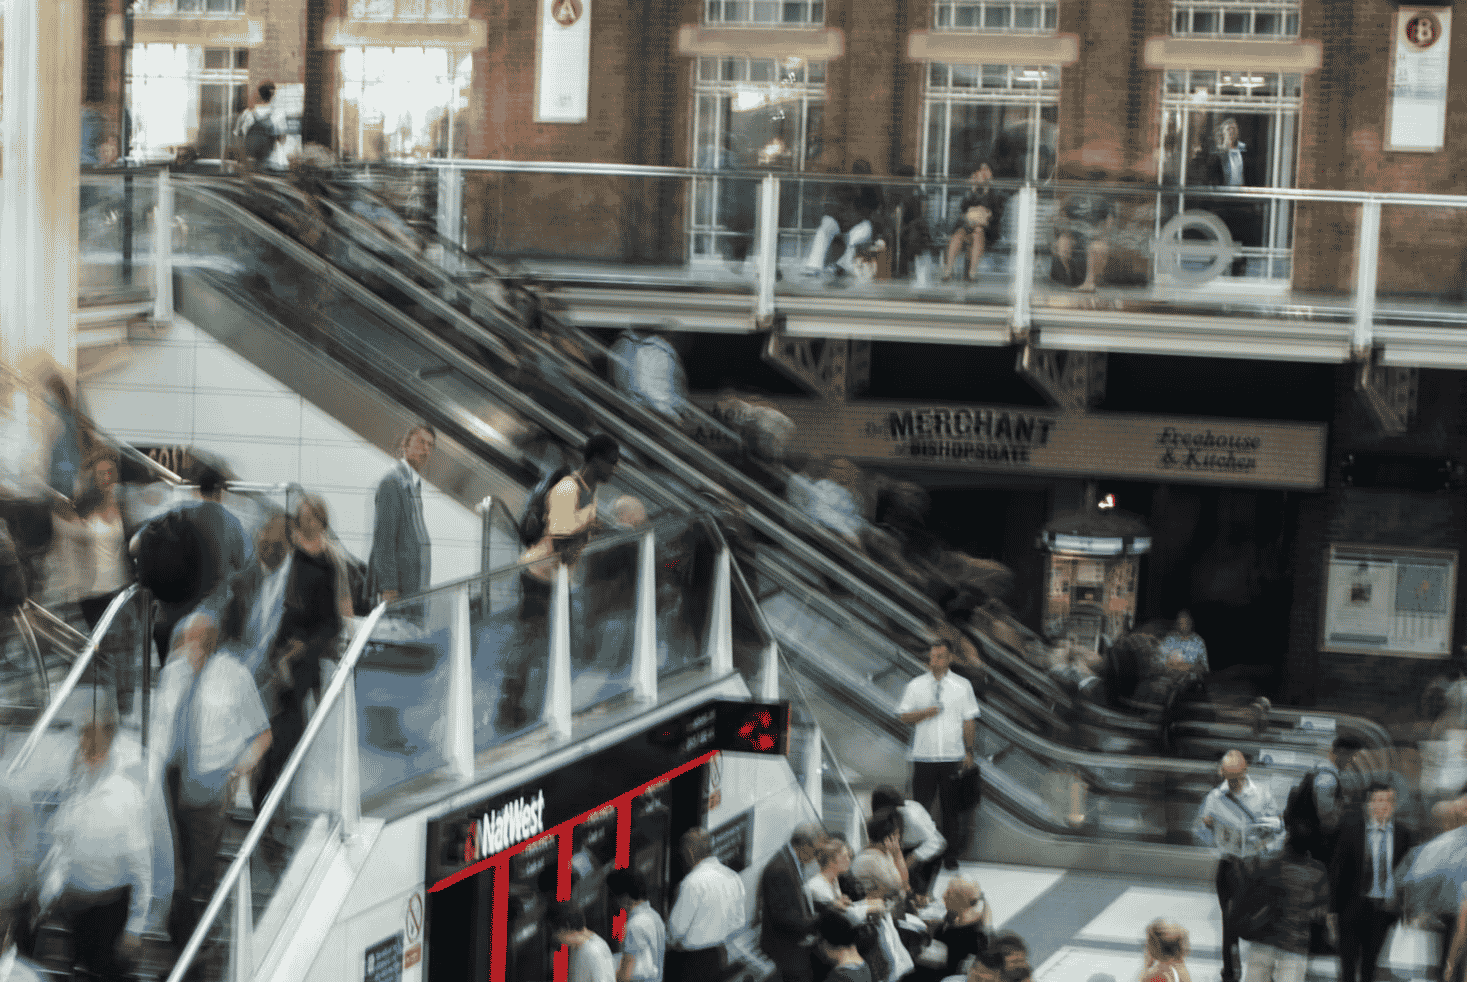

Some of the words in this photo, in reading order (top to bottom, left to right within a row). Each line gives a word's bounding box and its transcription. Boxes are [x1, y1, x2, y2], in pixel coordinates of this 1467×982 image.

[889, 408, 1057, 445] MERCHANT
[911, 440, 1031, 462] BISHOPSGATE
[479, 788, 545, 858] NatWest
